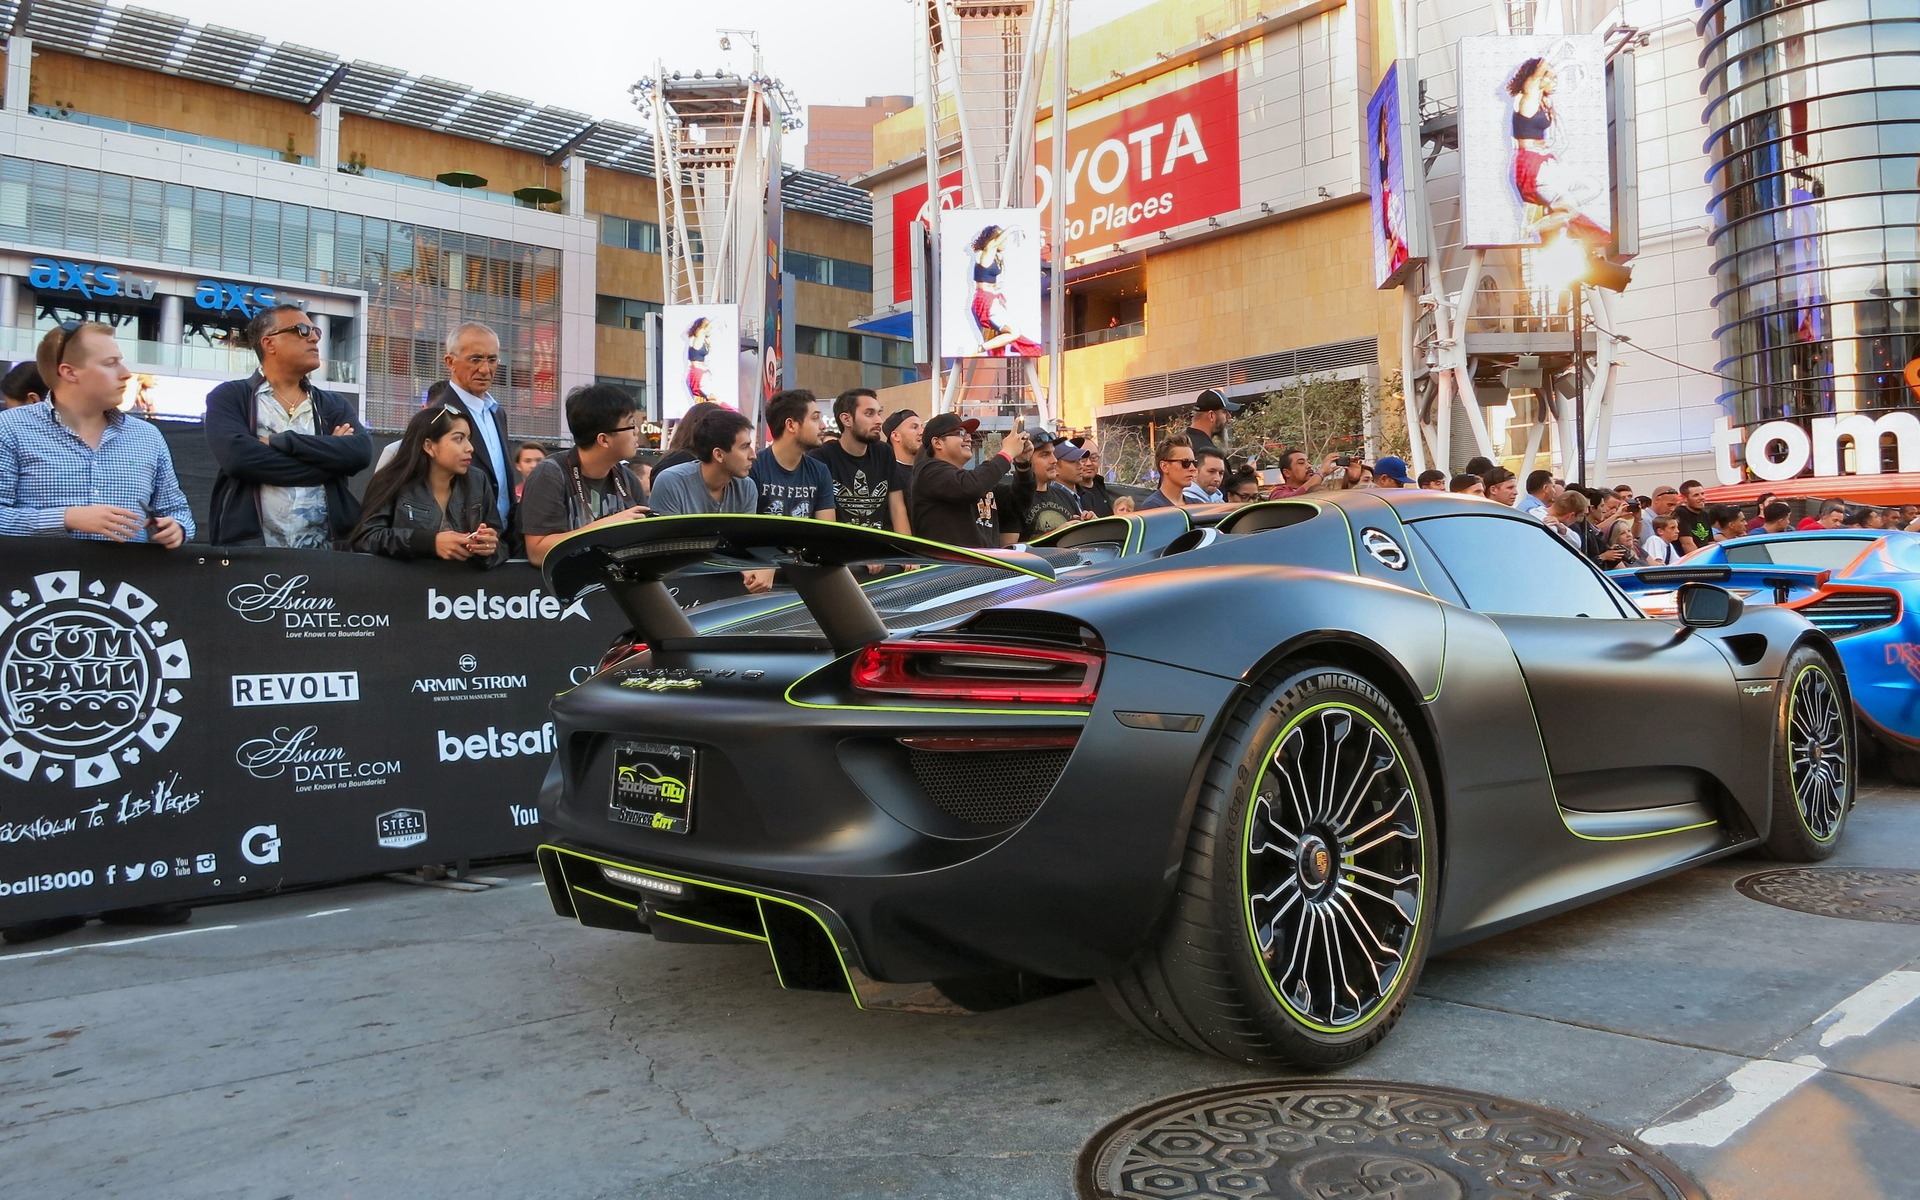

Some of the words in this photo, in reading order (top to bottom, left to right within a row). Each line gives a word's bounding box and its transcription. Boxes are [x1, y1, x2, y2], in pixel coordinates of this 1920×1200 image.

[1036, 113, 1208, 213] YOTA
[1089, 192, 1173, 235] Places
[29, 258, 159, 300] axs.tv
[641, 423, 663, 434] CON
[1710, 412, 1920, 486] tom
[762, 484, 785, 497] FYF
[787, 486, 817, 498] FEST
[227, 573, 336, 623] Asian
[428, 588, 561, 621] betsafe
[285, 612, 390, 628] DATE.COM
[338, 630, 375, 638] Boundaries
[8, 660, 140, 698] BALL
[236, 675, 355, 702] REVOLT
[411, 677, 467, 693] ARMIN
[472, 675, 528, 690] STROM
[1317, 674, 1390, 712] MICHELIN
[236, 725, 346, 779] Asian
[437, 721, 558, 762] betsaf
[294, 760, 401, 782] DATE.COM
[295, 785, 312, 793] Love
[313, 782, 336, 791] Knows
[348, 778, 386, 788] Boundaries
[382, 817, 421, 831] STEEL
[510, 804, 539, 827] You
[174, 866, 191, 876] Tube
[175, 857, 189, 867] You
[0, 869, 95, 896] ball3000
